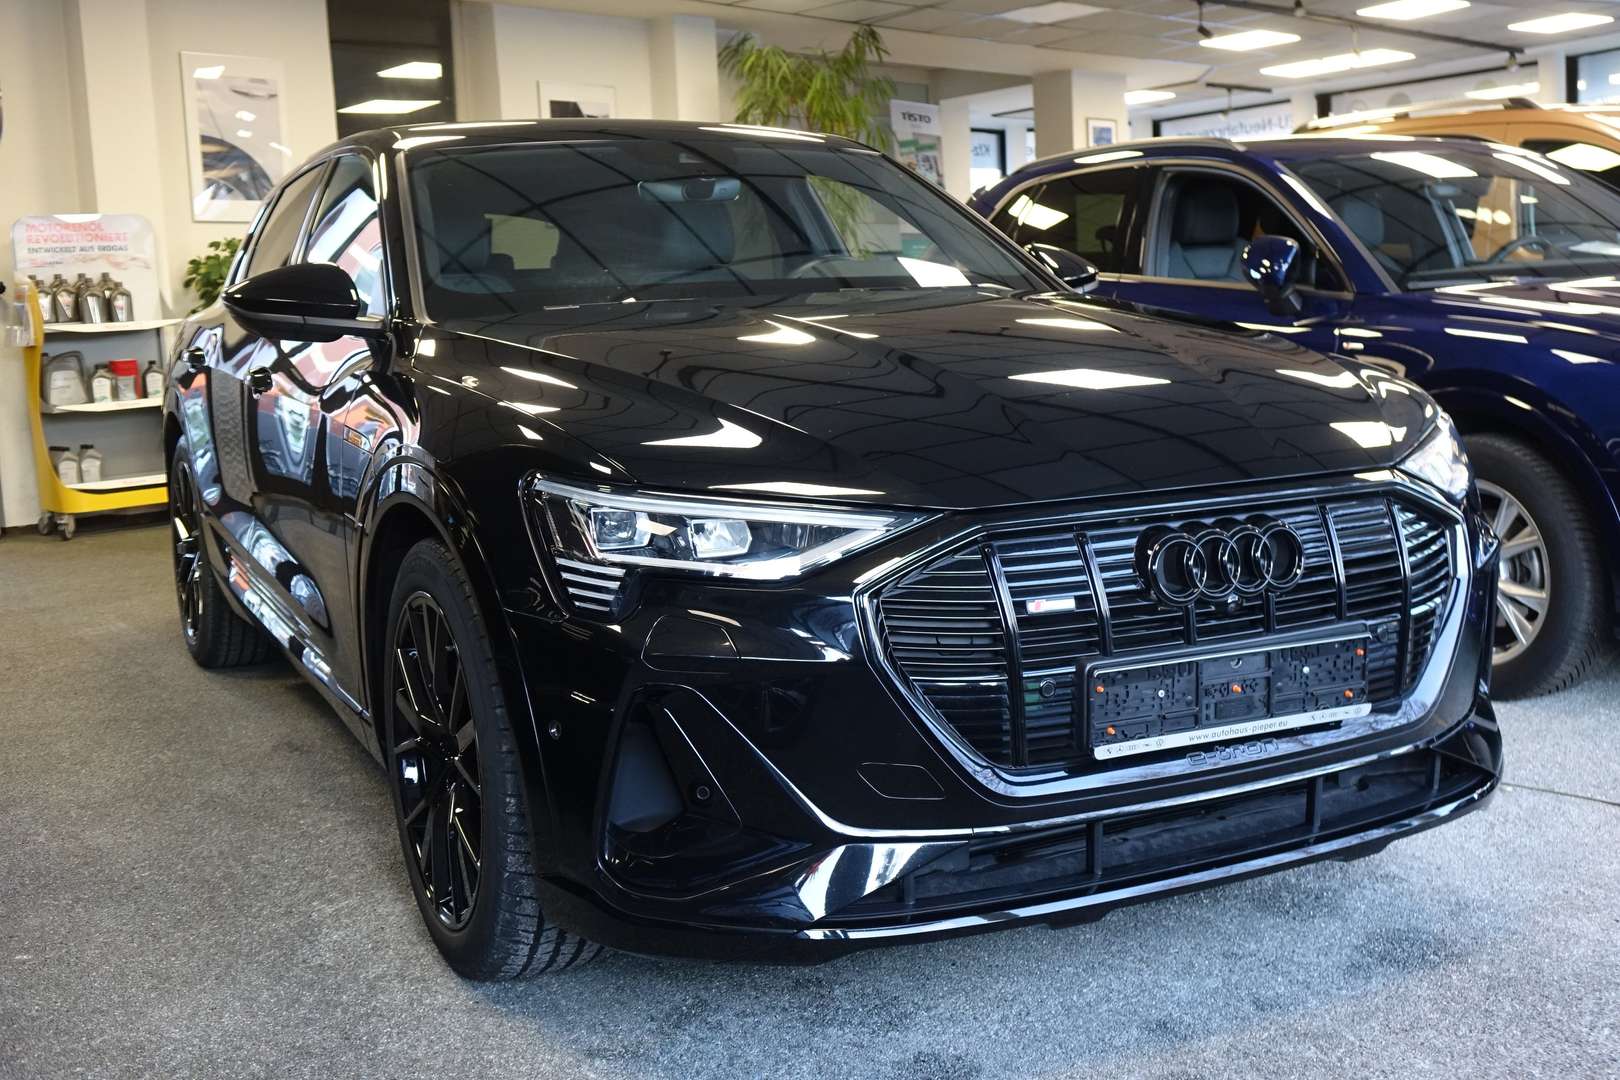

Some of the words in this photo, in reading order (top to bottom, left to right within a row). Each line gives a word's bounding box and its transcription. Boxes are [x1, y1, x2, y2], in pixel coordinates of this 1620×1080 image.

[28, 246, 76, 254] ENTWICKELT
[1188, 719, 1288, 742] www.autohaus-pieper.eu
[1186, 738, 1279, 766] e-tron
